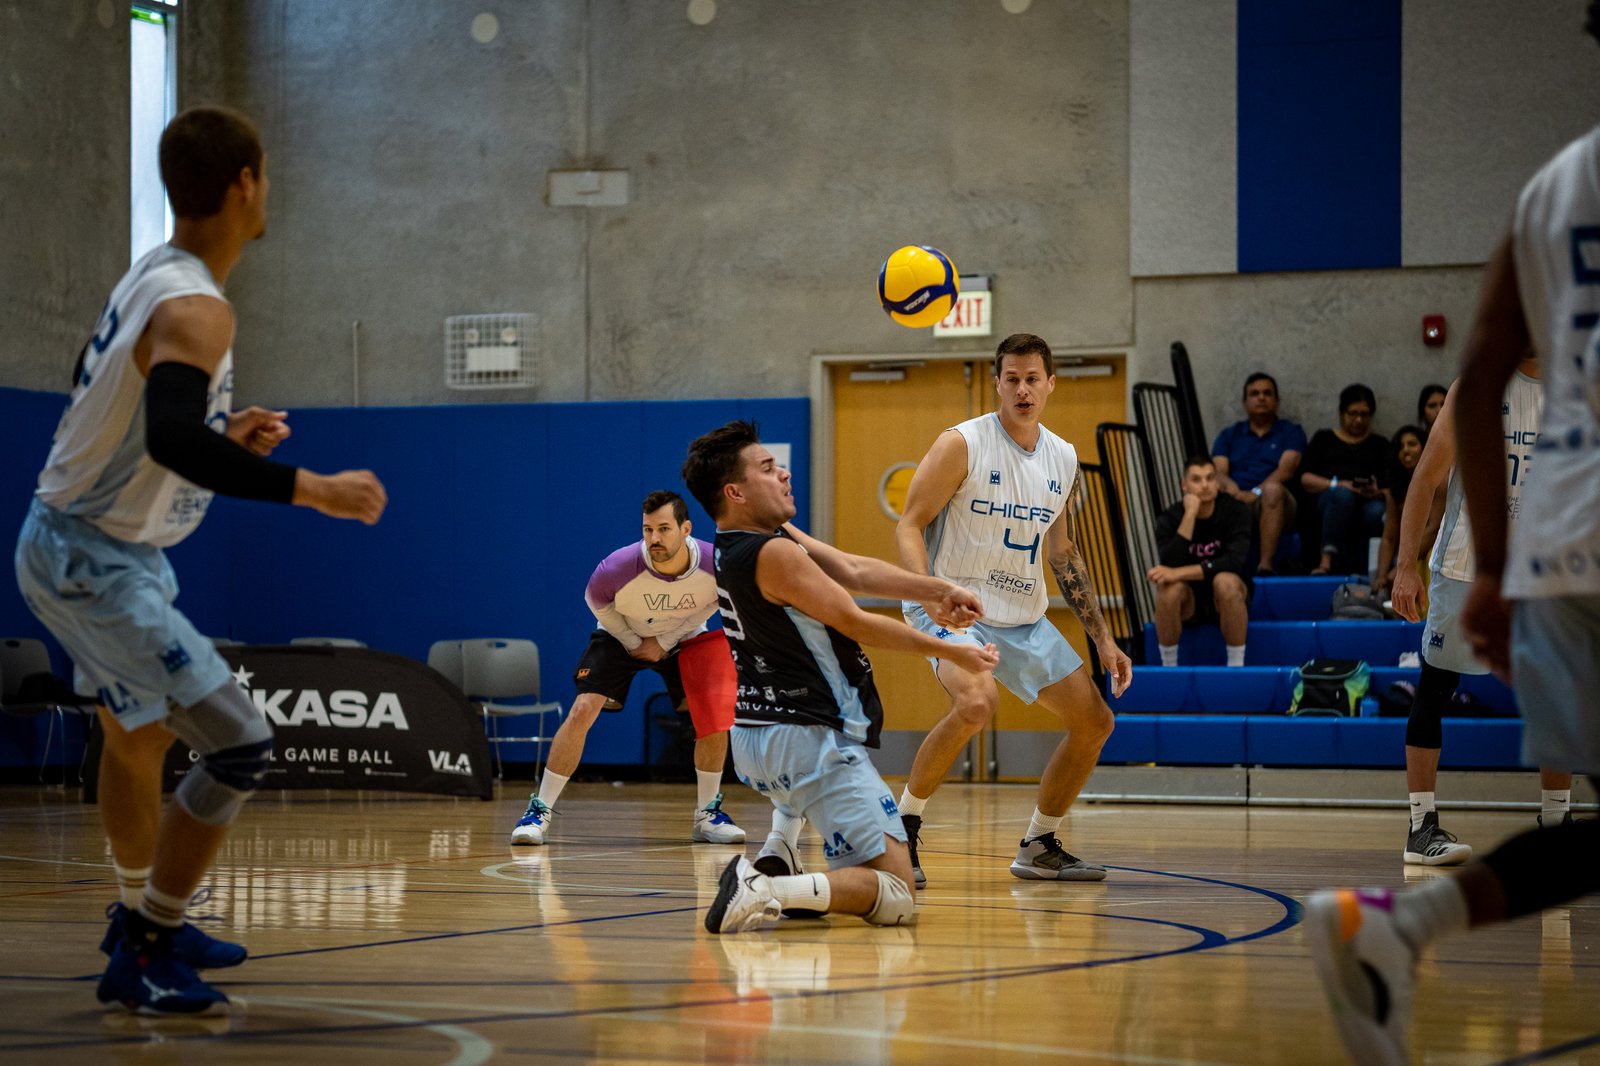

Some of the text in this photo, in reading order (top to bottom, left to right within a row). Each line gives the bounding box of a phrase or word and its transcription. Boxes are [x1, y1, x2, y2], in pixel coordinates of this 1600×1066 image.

[1003, 528, 1040, 565] 4
[990, 574, 1032, 592] KEHOE
[994, 584, 1022, 594] GROUP
[643, 593, 697, 611] VLA
[252, 688, 410, 731] KASA
[284, 747, 340, 763] GAME
[348, 749, 393, 764] BALL
[428, 750, 473, 774] VLA
